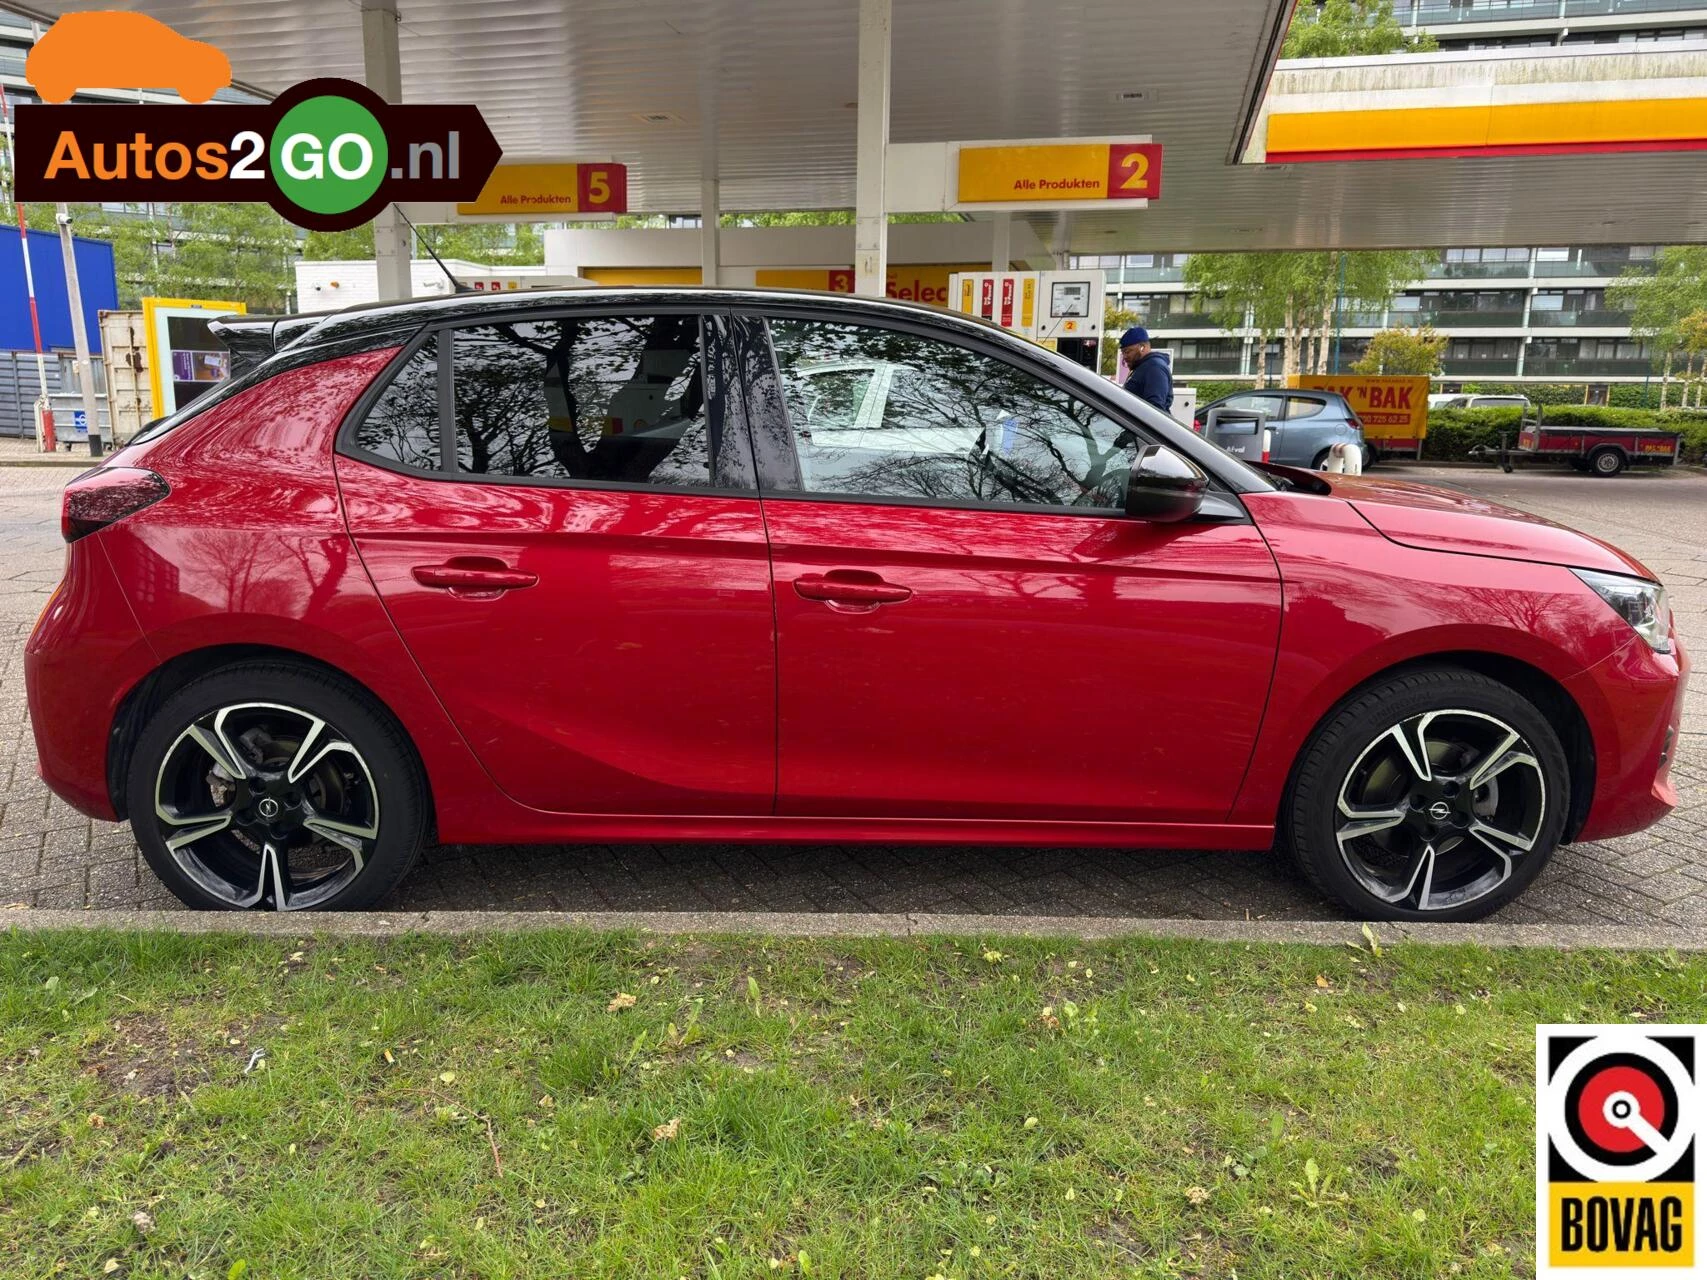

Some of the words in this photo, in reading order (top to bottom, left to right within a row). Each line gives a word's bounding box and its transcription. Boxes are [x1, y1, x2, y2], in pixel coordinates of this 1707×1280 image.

[1119, 152, 1149, 190] 2
[589, 171, 611, 204] 5
[1014, 179, 1036, 190] Alle
[1039, 178, 1100, 190] Produkten
[500, 195, 520, 205] Alle
[521, 194, 572, 205] Produkten
[835, 275, 849, 293] 3
[1369, 386, 1413, 410] BAK
